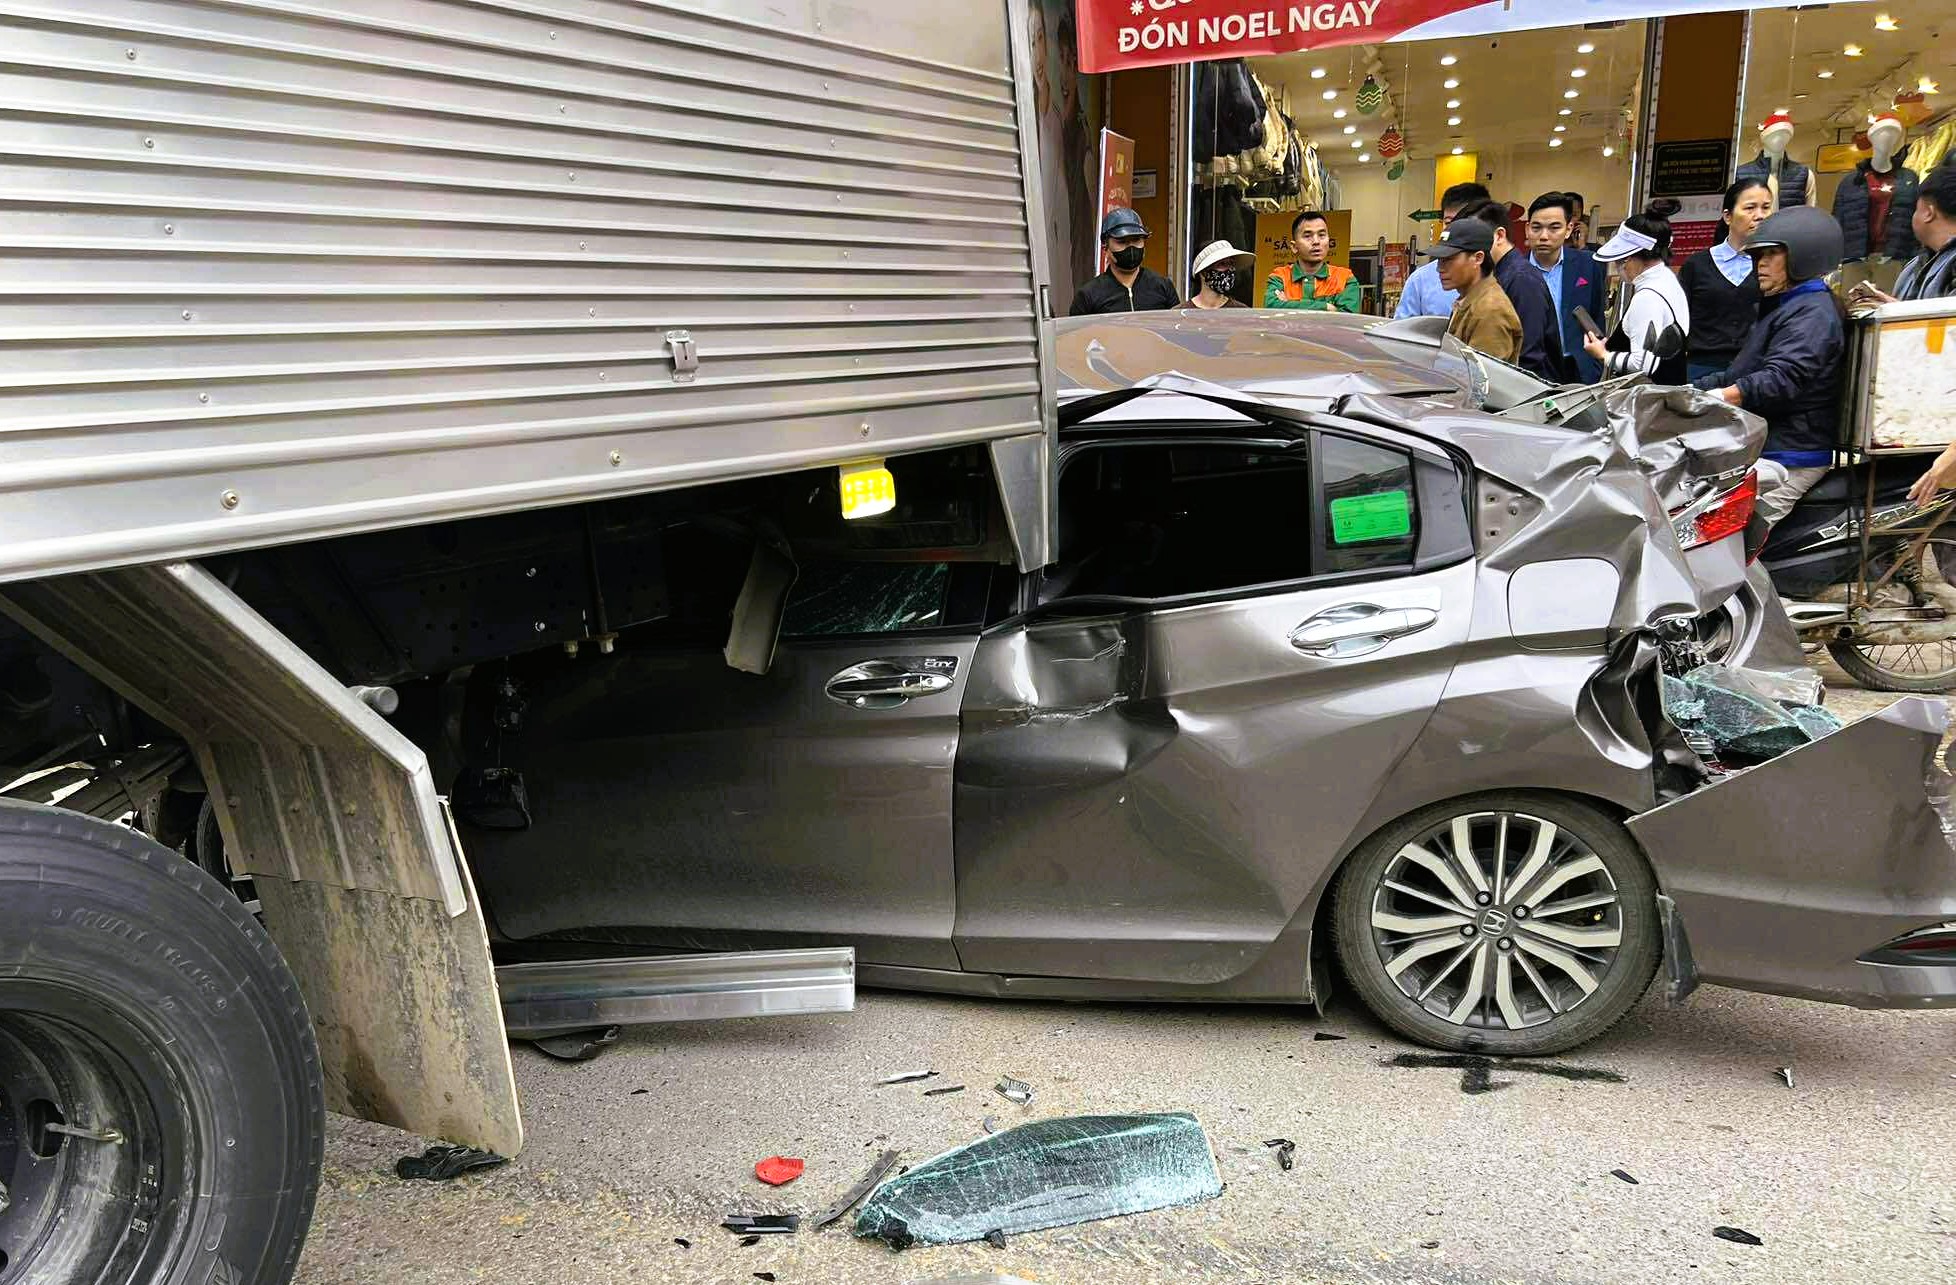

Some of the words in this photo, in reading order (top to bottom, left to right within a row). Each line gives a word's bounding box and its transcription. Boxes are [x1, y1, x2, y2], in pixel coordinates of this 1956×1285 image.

[1118, 17, 1189, 53] ĐÓN
[1198, 11, 1281, 45] NOEL
[1288, 0, 1381, 33] NGAY
